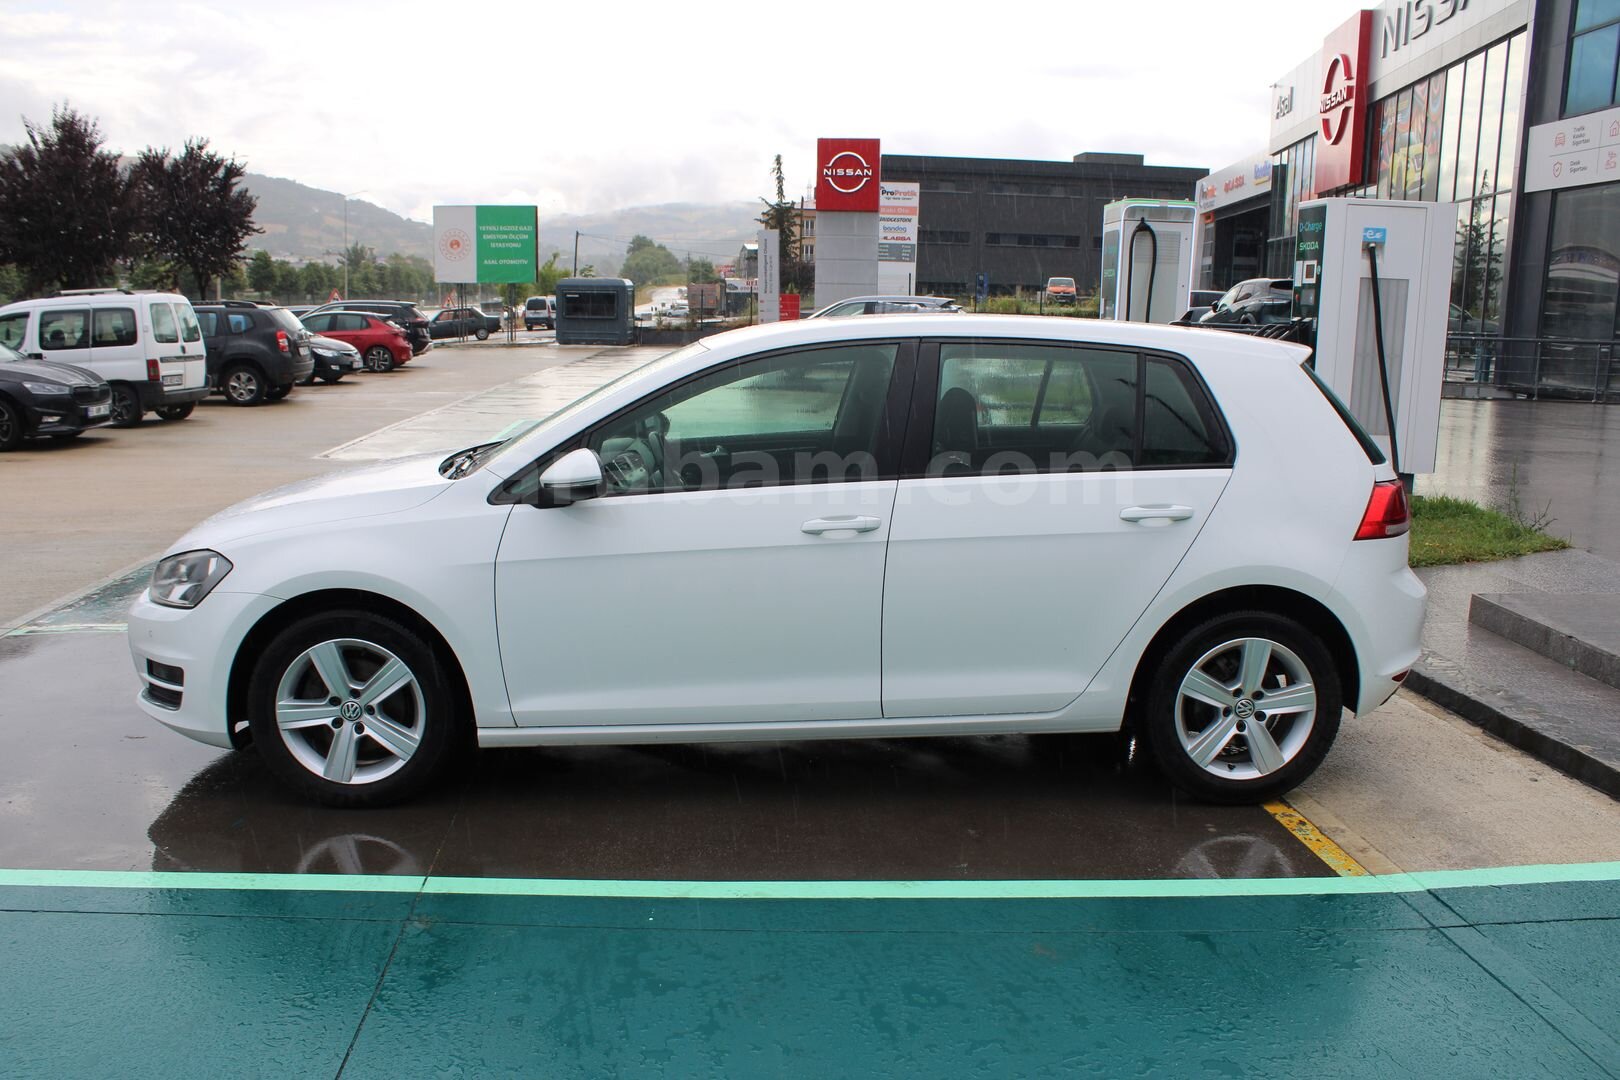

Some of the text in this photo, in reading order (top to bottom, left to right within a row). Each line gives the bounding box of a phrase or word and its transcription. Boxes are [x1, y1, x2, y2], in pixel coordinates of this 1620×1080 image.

[1380, 0, 1468, 58] NISS
[1275, 86, 1294, 120] Asal
[1320, 87, 1347, 113] NISSAN
[823, 168, 873, 176] NISSAN
